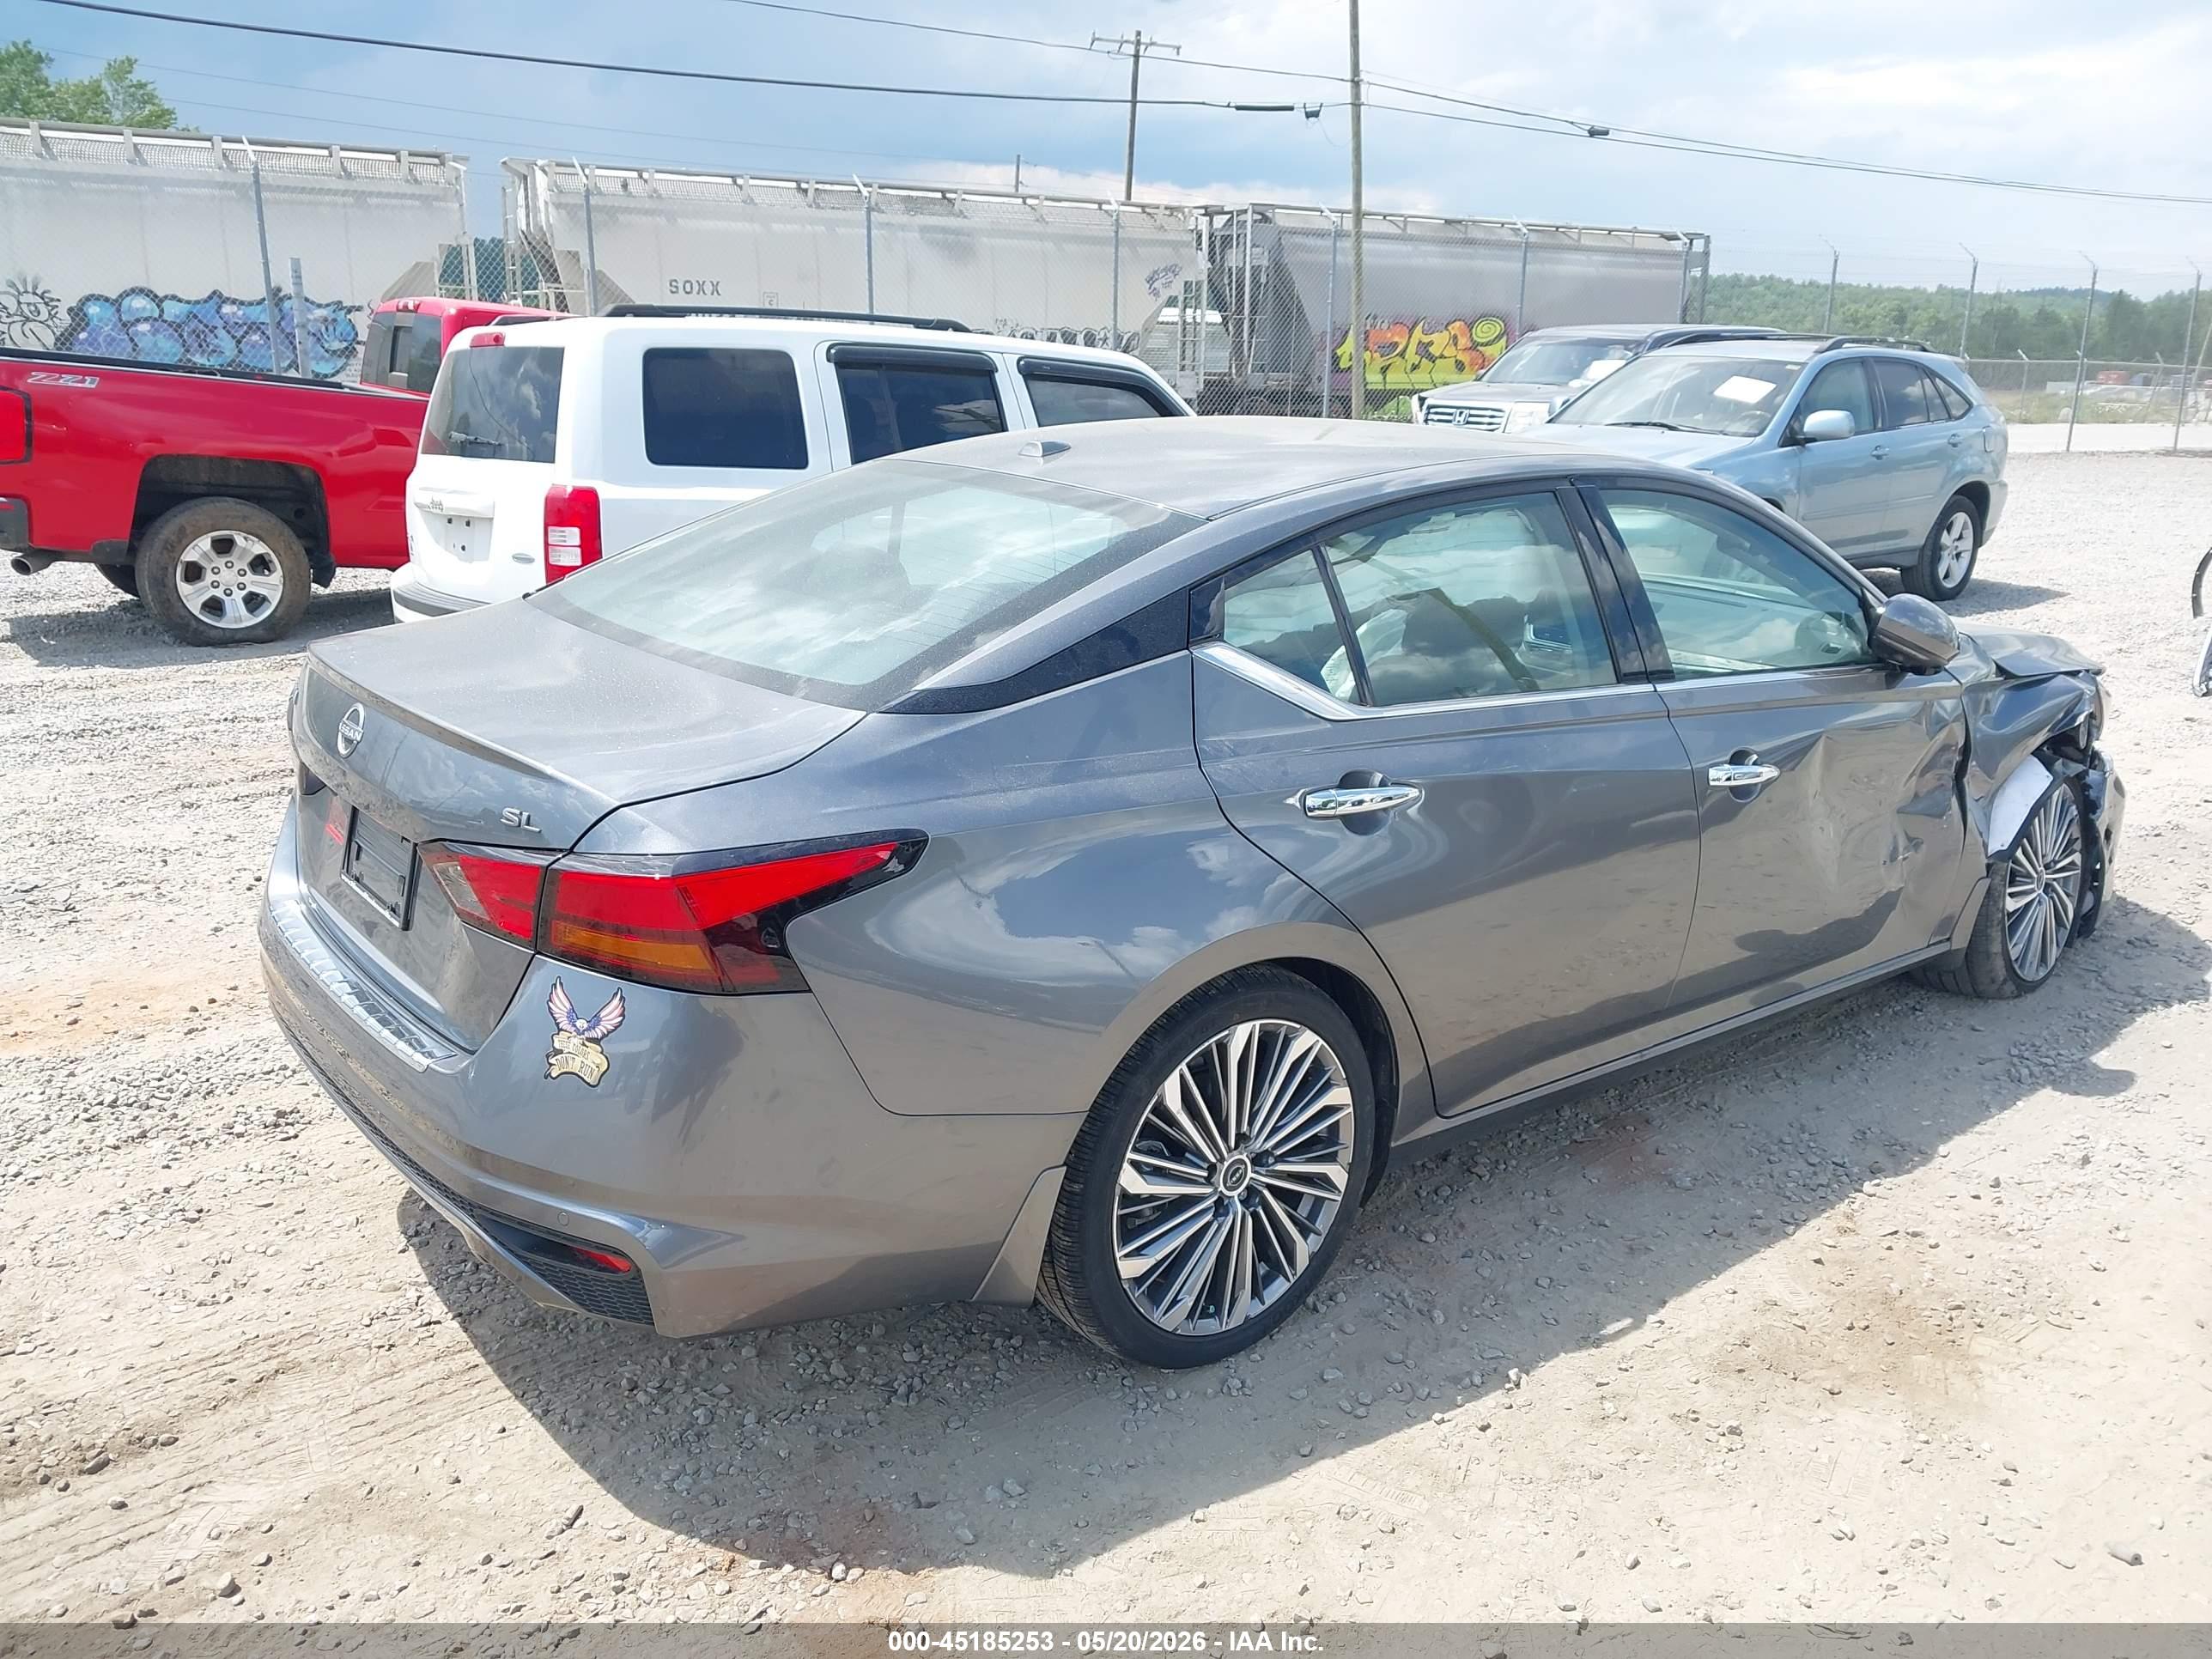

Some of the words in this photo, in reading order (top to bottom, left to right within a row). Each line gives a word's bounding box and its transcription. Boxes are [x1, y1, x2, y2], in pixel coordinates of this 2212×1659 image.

[669, 278, 721, 295] SOXX
[500, 807, 542, 833] SL
[556, 1055, 576, 1072] DON'T
[578, 1060, 596, 1080] RUN
